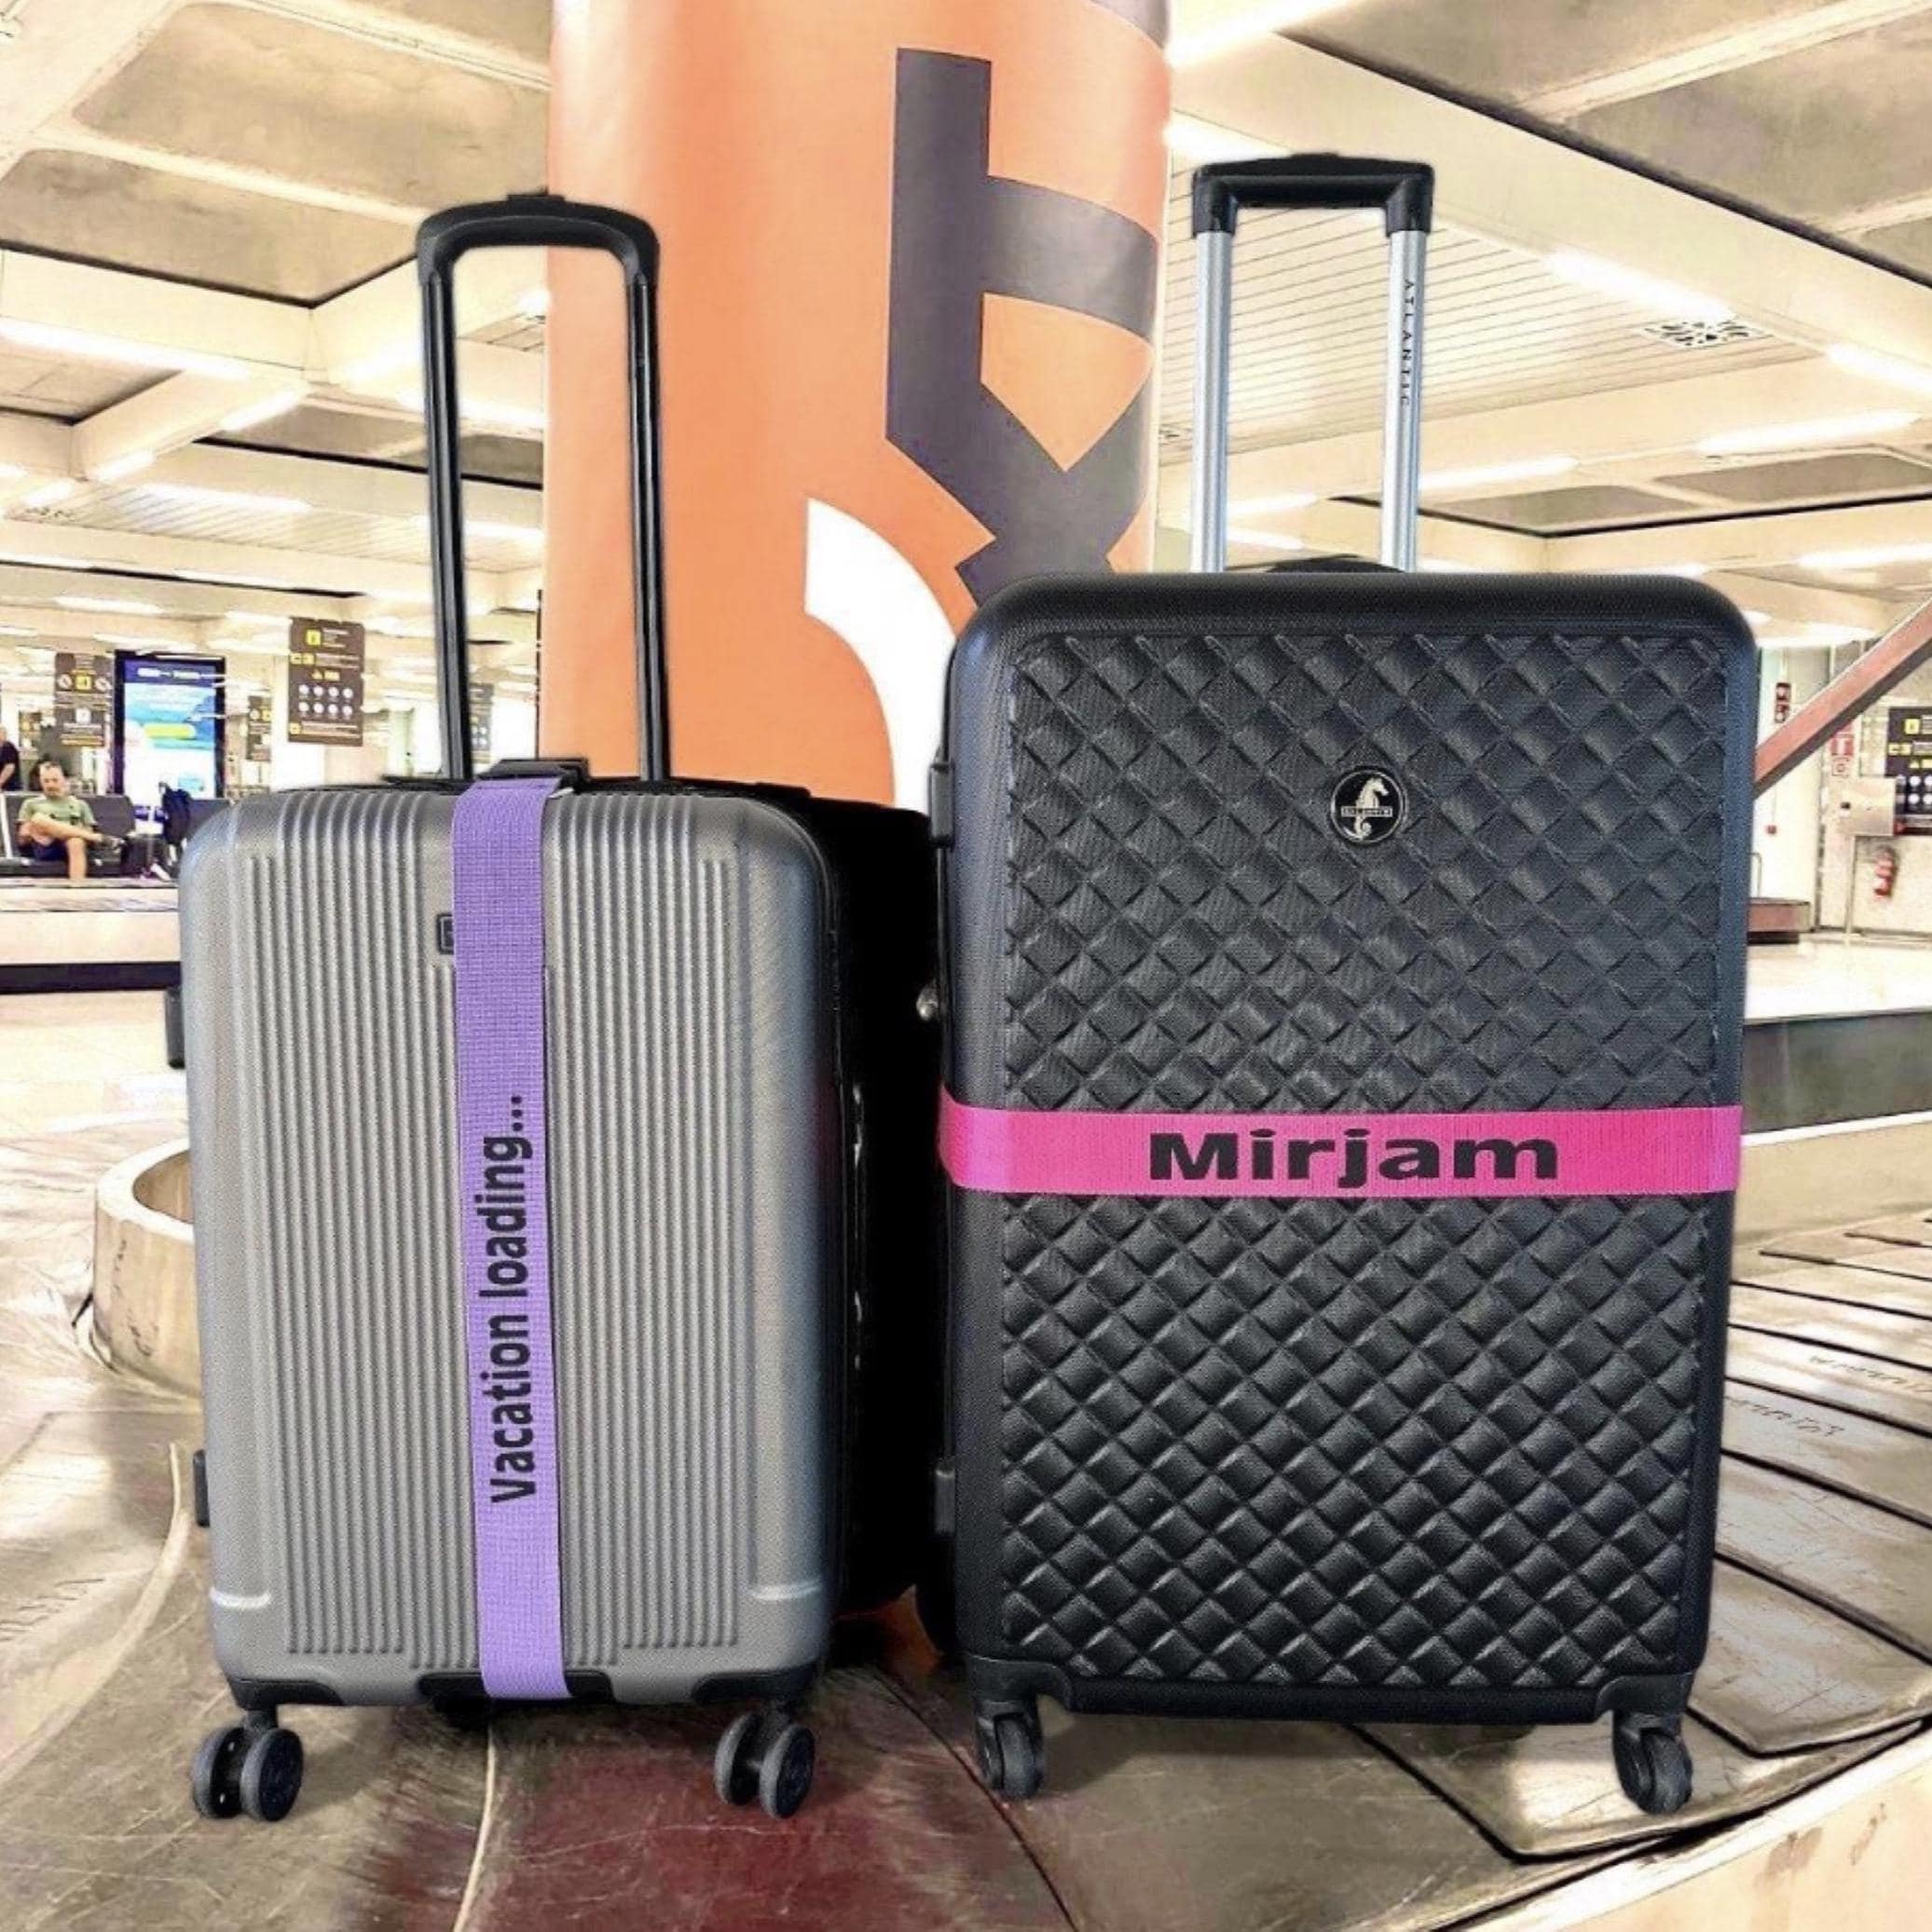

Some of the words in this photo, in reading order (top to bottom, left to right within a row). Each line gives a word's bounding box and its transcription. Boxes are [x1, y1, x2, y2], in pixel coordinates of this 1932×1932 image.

[1400, 279, 1416, 406] ATLANTIC
[473, 1095, 534, 1297] loading...
[1149, 1128, 1557, 1189] Mirjam
[479, 1314, 536, 1503] Vacation
